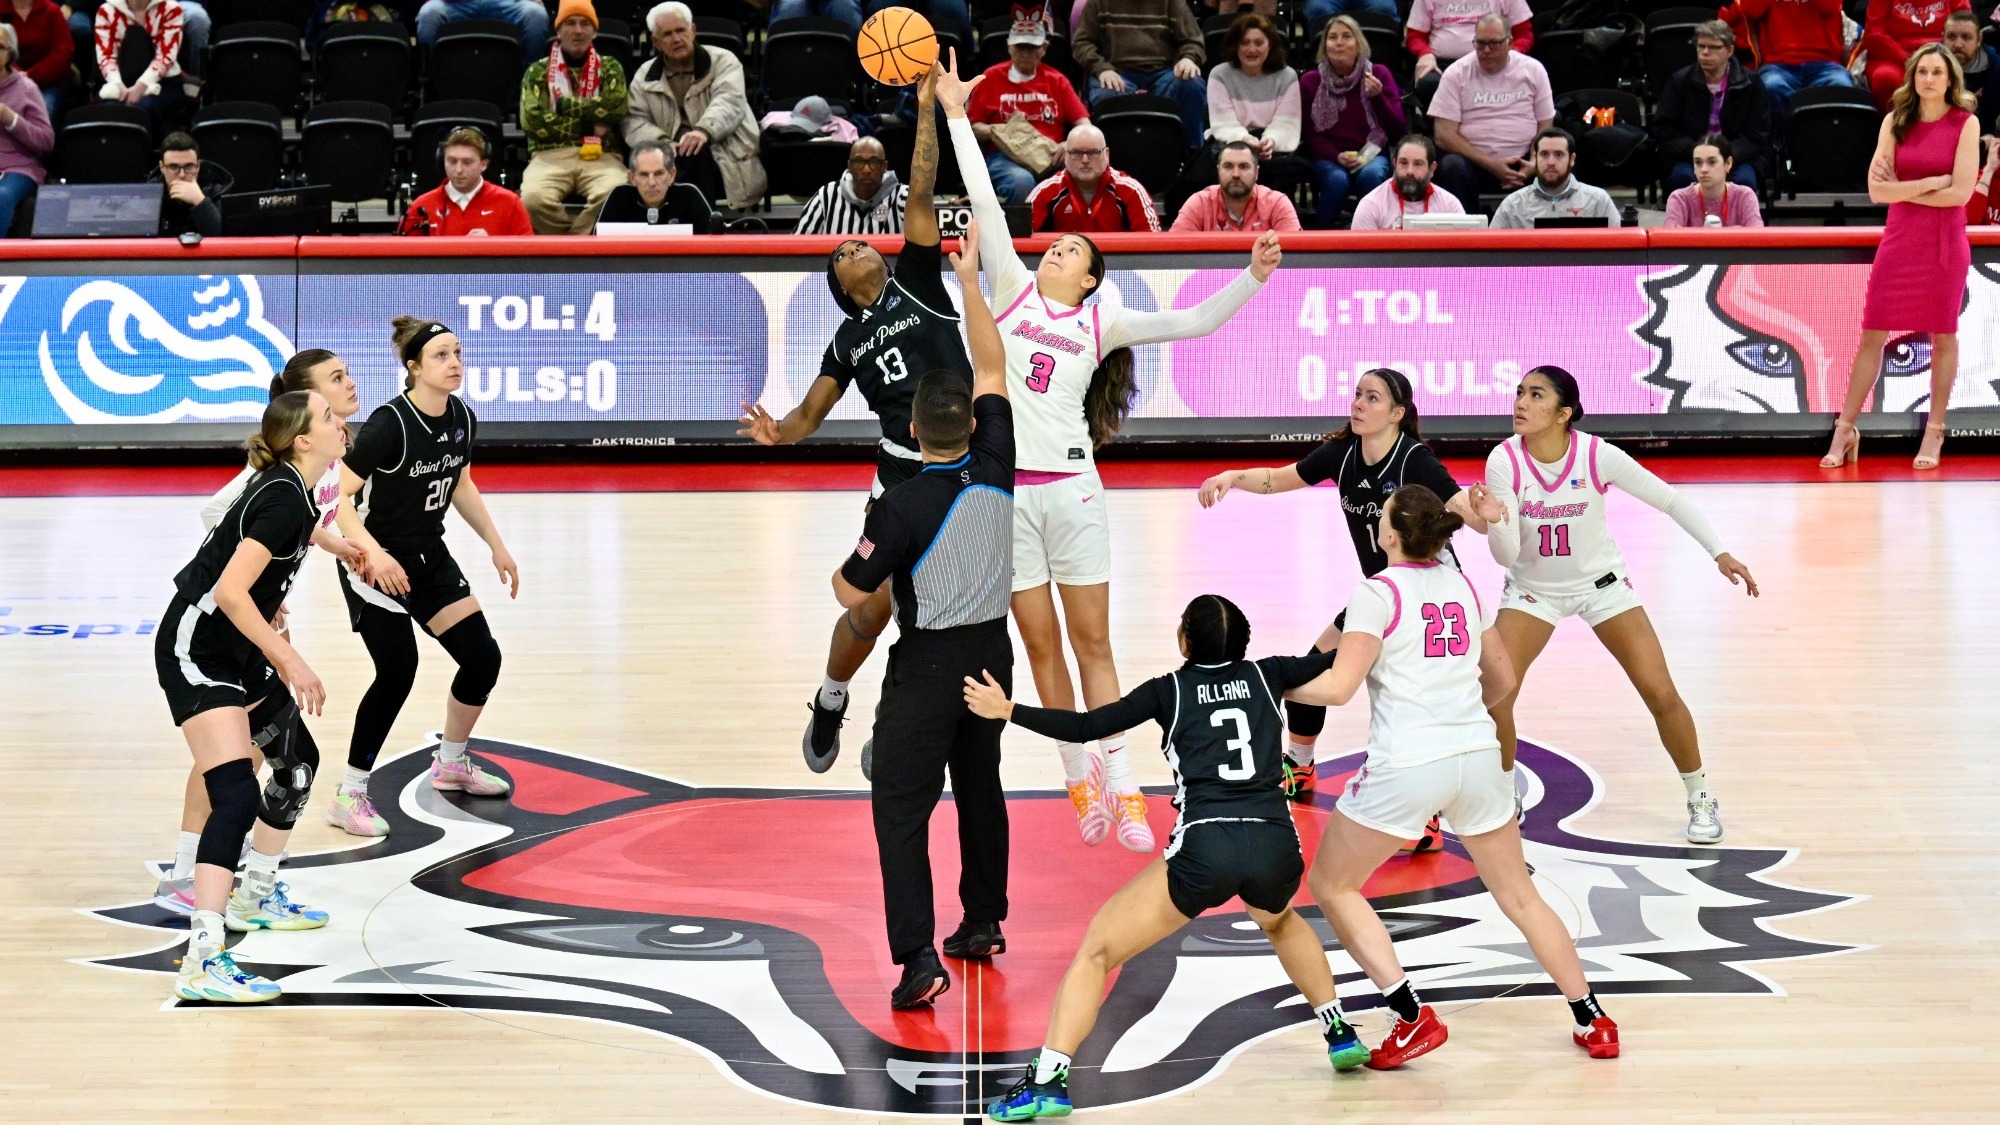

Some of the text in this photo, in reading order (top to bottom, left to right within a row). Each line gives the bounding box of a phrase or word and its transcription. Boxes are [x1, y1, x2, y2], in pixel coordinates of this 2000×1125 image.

[850, 313, 921, 367] Saint Peter's
[1011, 319, 1086, 356] MARIST
[875, 347, 908, 385] 13
[1025, 351, 1056, 394] 3
[592, 437, 676, 446] DAKTRONICS
[408, 460, 441, 477] Saint
[424, 476, 453, 511] 20
[1341, 495, 1365, 515] Saint
[1519, 500, 1589, 519] MARIST
[1538, 523, 1571, 557] 11
[1420, 601, 1471, 658] 23
[1196, 679, 1252, 705] ALLANA
[1209, 707, 1257, 781] 3
